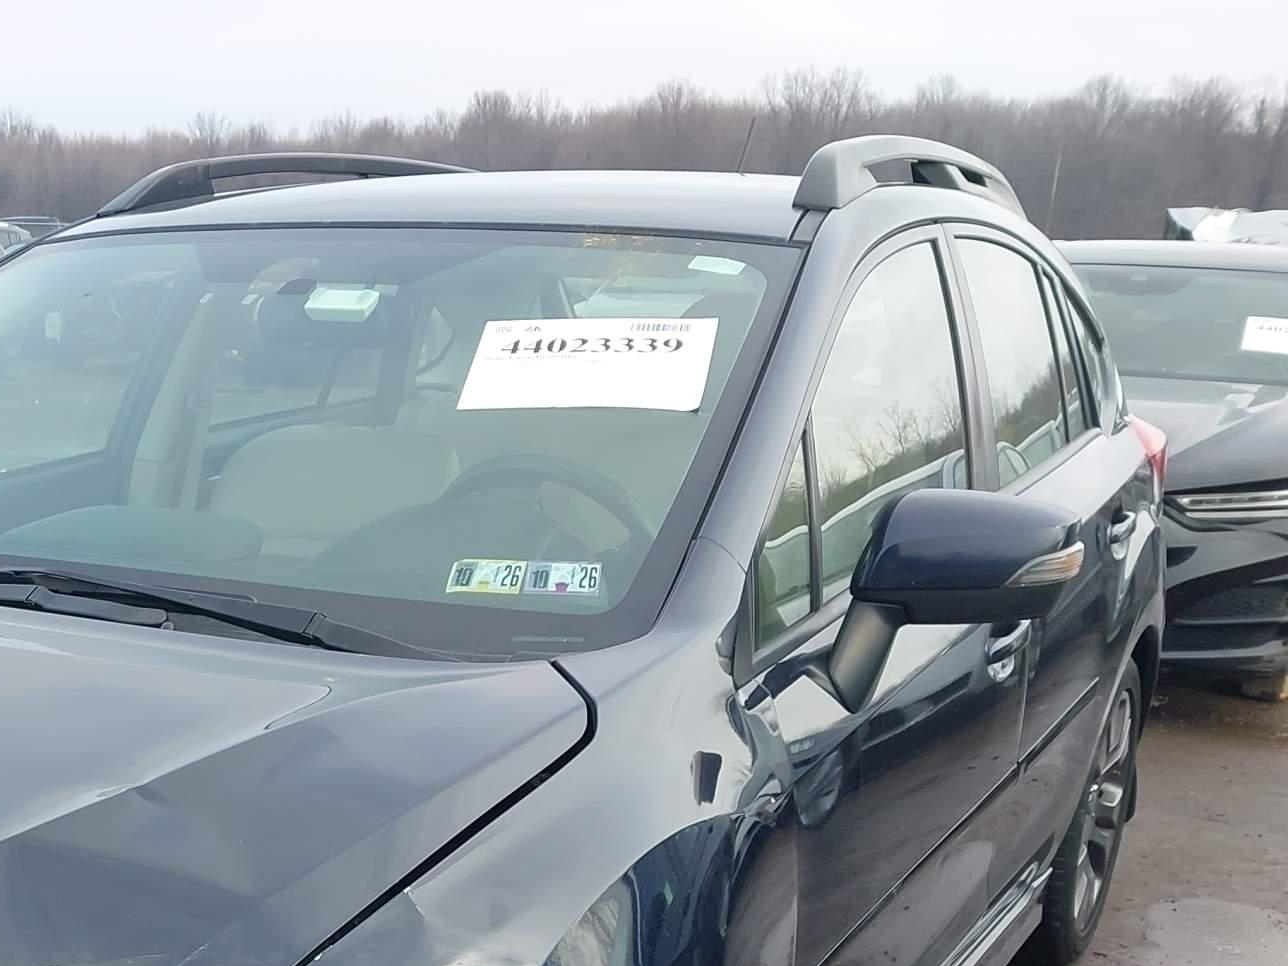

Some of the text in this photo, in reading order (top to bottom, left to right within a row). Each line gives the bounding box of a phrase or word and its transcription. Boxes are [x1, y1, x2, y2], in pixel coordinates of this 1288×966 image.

[500, 337, 685, 354] 44023339
[455, 567, 474, 587] 10
[500, 565, 522, 587] 26
[533, 569, 550, 589] 10
[578, 566, 598, 589] 26
